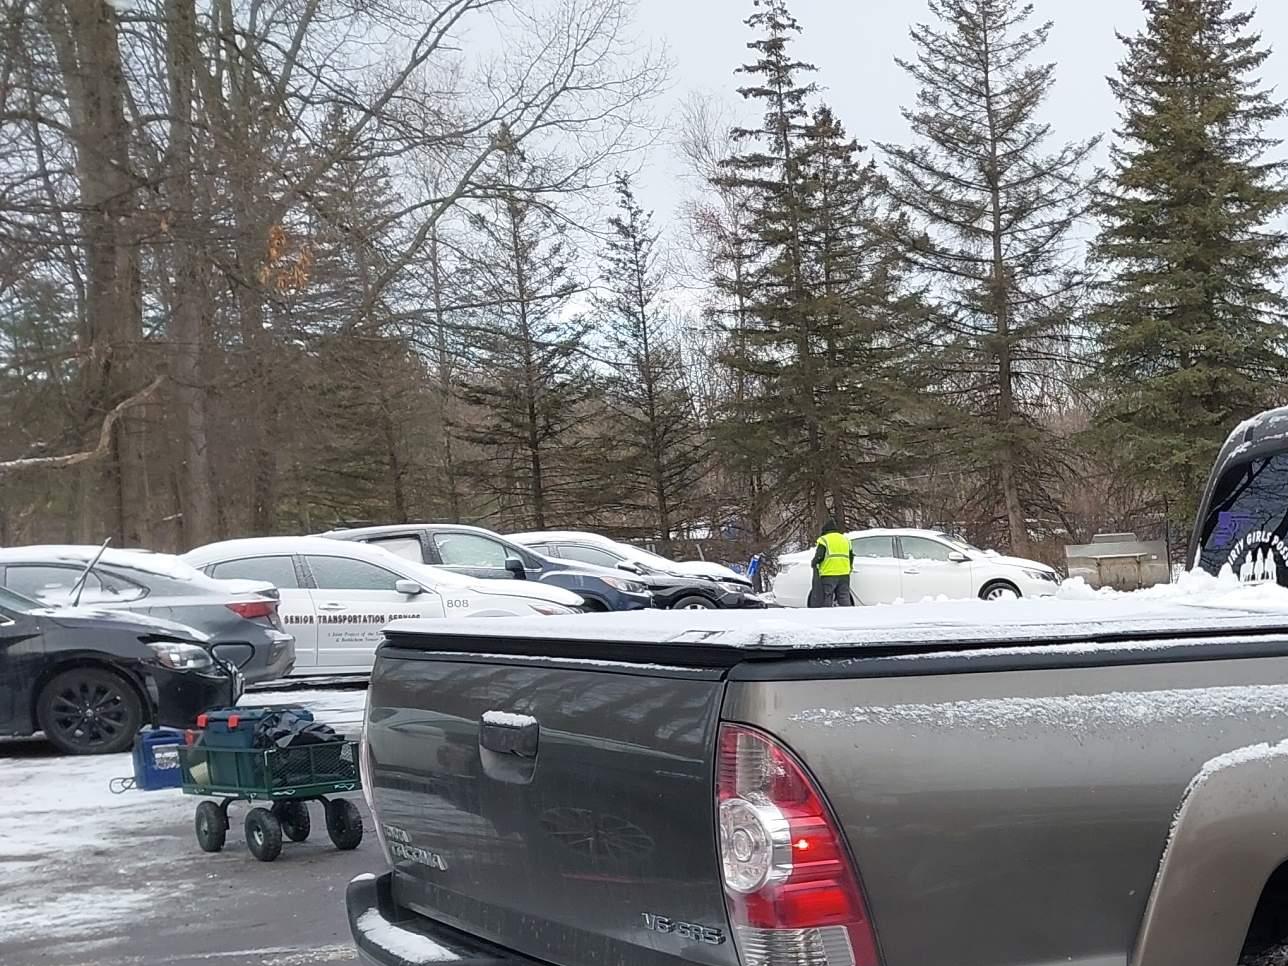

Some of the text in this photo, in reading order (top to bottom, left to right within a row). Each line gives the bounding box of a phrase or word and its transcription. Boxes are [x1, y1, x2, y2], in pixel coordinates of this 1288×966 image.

[1227, 537, 1244, 566] IRTY
[1246, 530, 1273, 546] GIRLS
[446, 599, 470, 609] 808
[284, 614, 315, 625] SENIOR
[317, 613, 386, 625] TRANSPORTATION
[640, 912, 675, 934] V6
